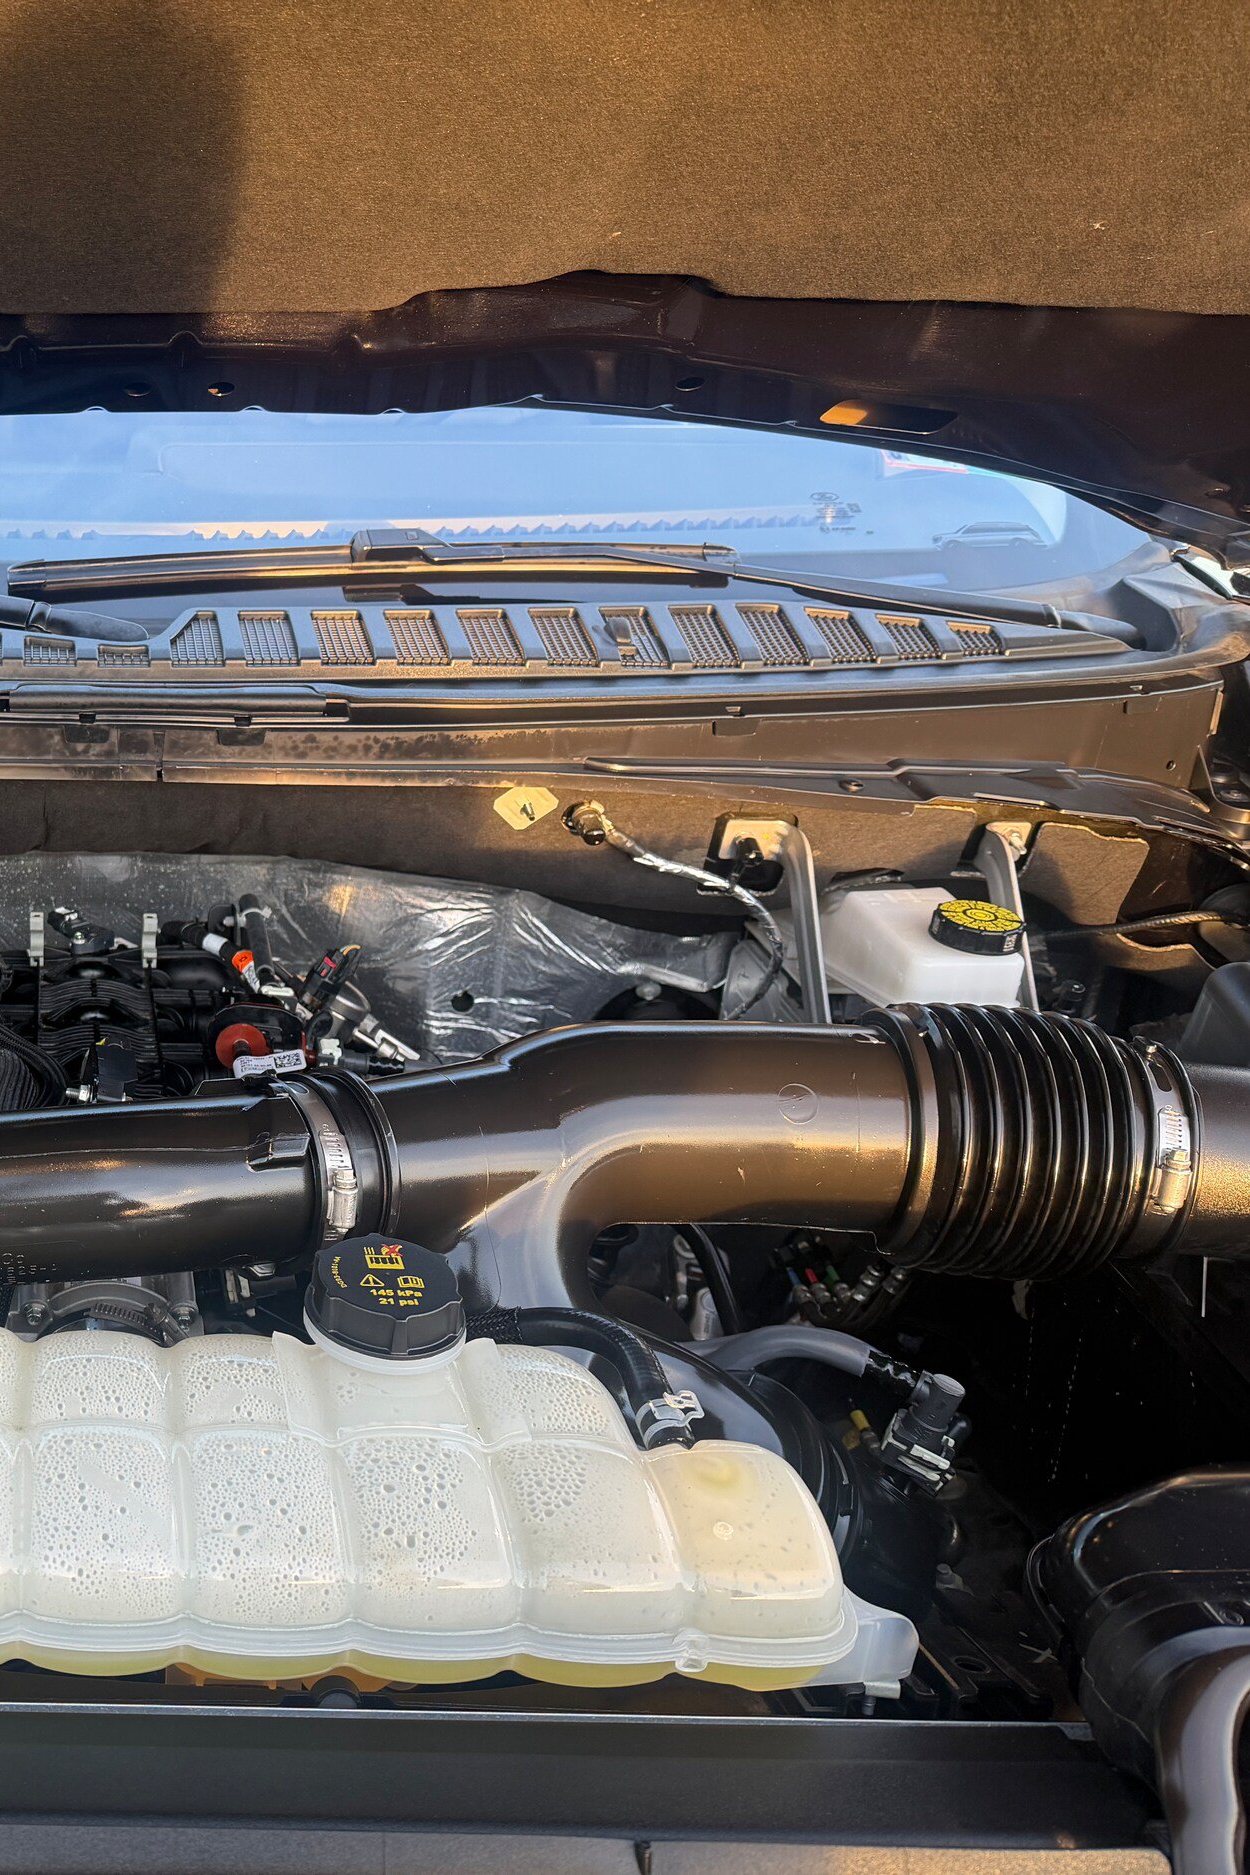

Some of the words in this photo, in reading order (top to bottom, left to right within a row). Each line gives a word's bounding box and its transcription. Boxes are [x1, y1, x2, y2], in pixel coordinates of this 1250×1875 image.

[370, 1289, 393, 1297] 145
[397, 1289, 423, 1298] kPa
[379, 1297, 395, 1305] 21
[399, 1298, 419, 1307] psi
